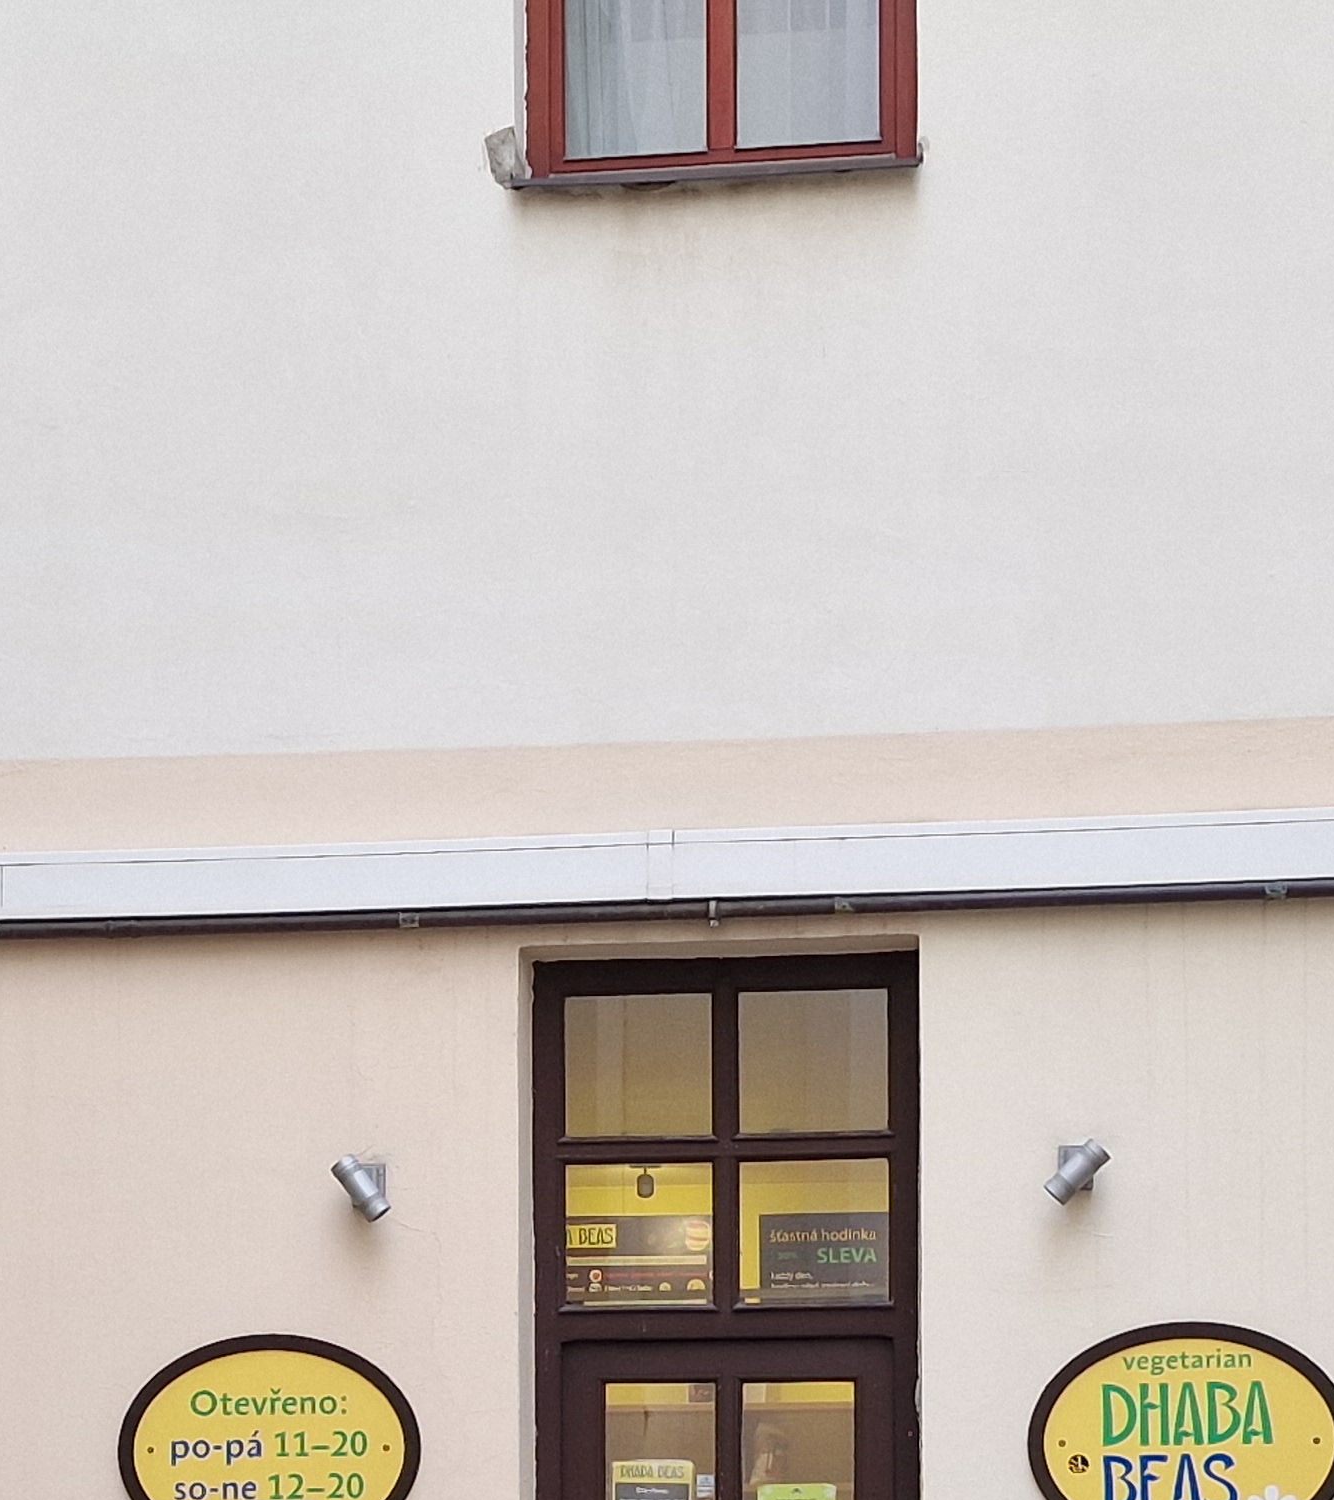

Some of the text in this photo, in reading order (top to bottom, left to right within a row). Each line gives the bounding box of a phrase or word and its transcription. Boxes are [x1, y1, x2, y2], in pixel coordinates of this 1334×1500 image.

[578, 1227, 614, 1246] BEAS
[820, 1227, 877, 1242] hodinka
[816, 1247, 877, 1264] SLEVA
[1122, 1349, 1253, 1376] vegetarian
[189, 1388, 348, 1417] Otevřeno:
[1101, 1379, 1274, 1447] DHABA
[170, 1430, 263, 1466] po-pá
[174, 1480, 258, 1500] so-ne
